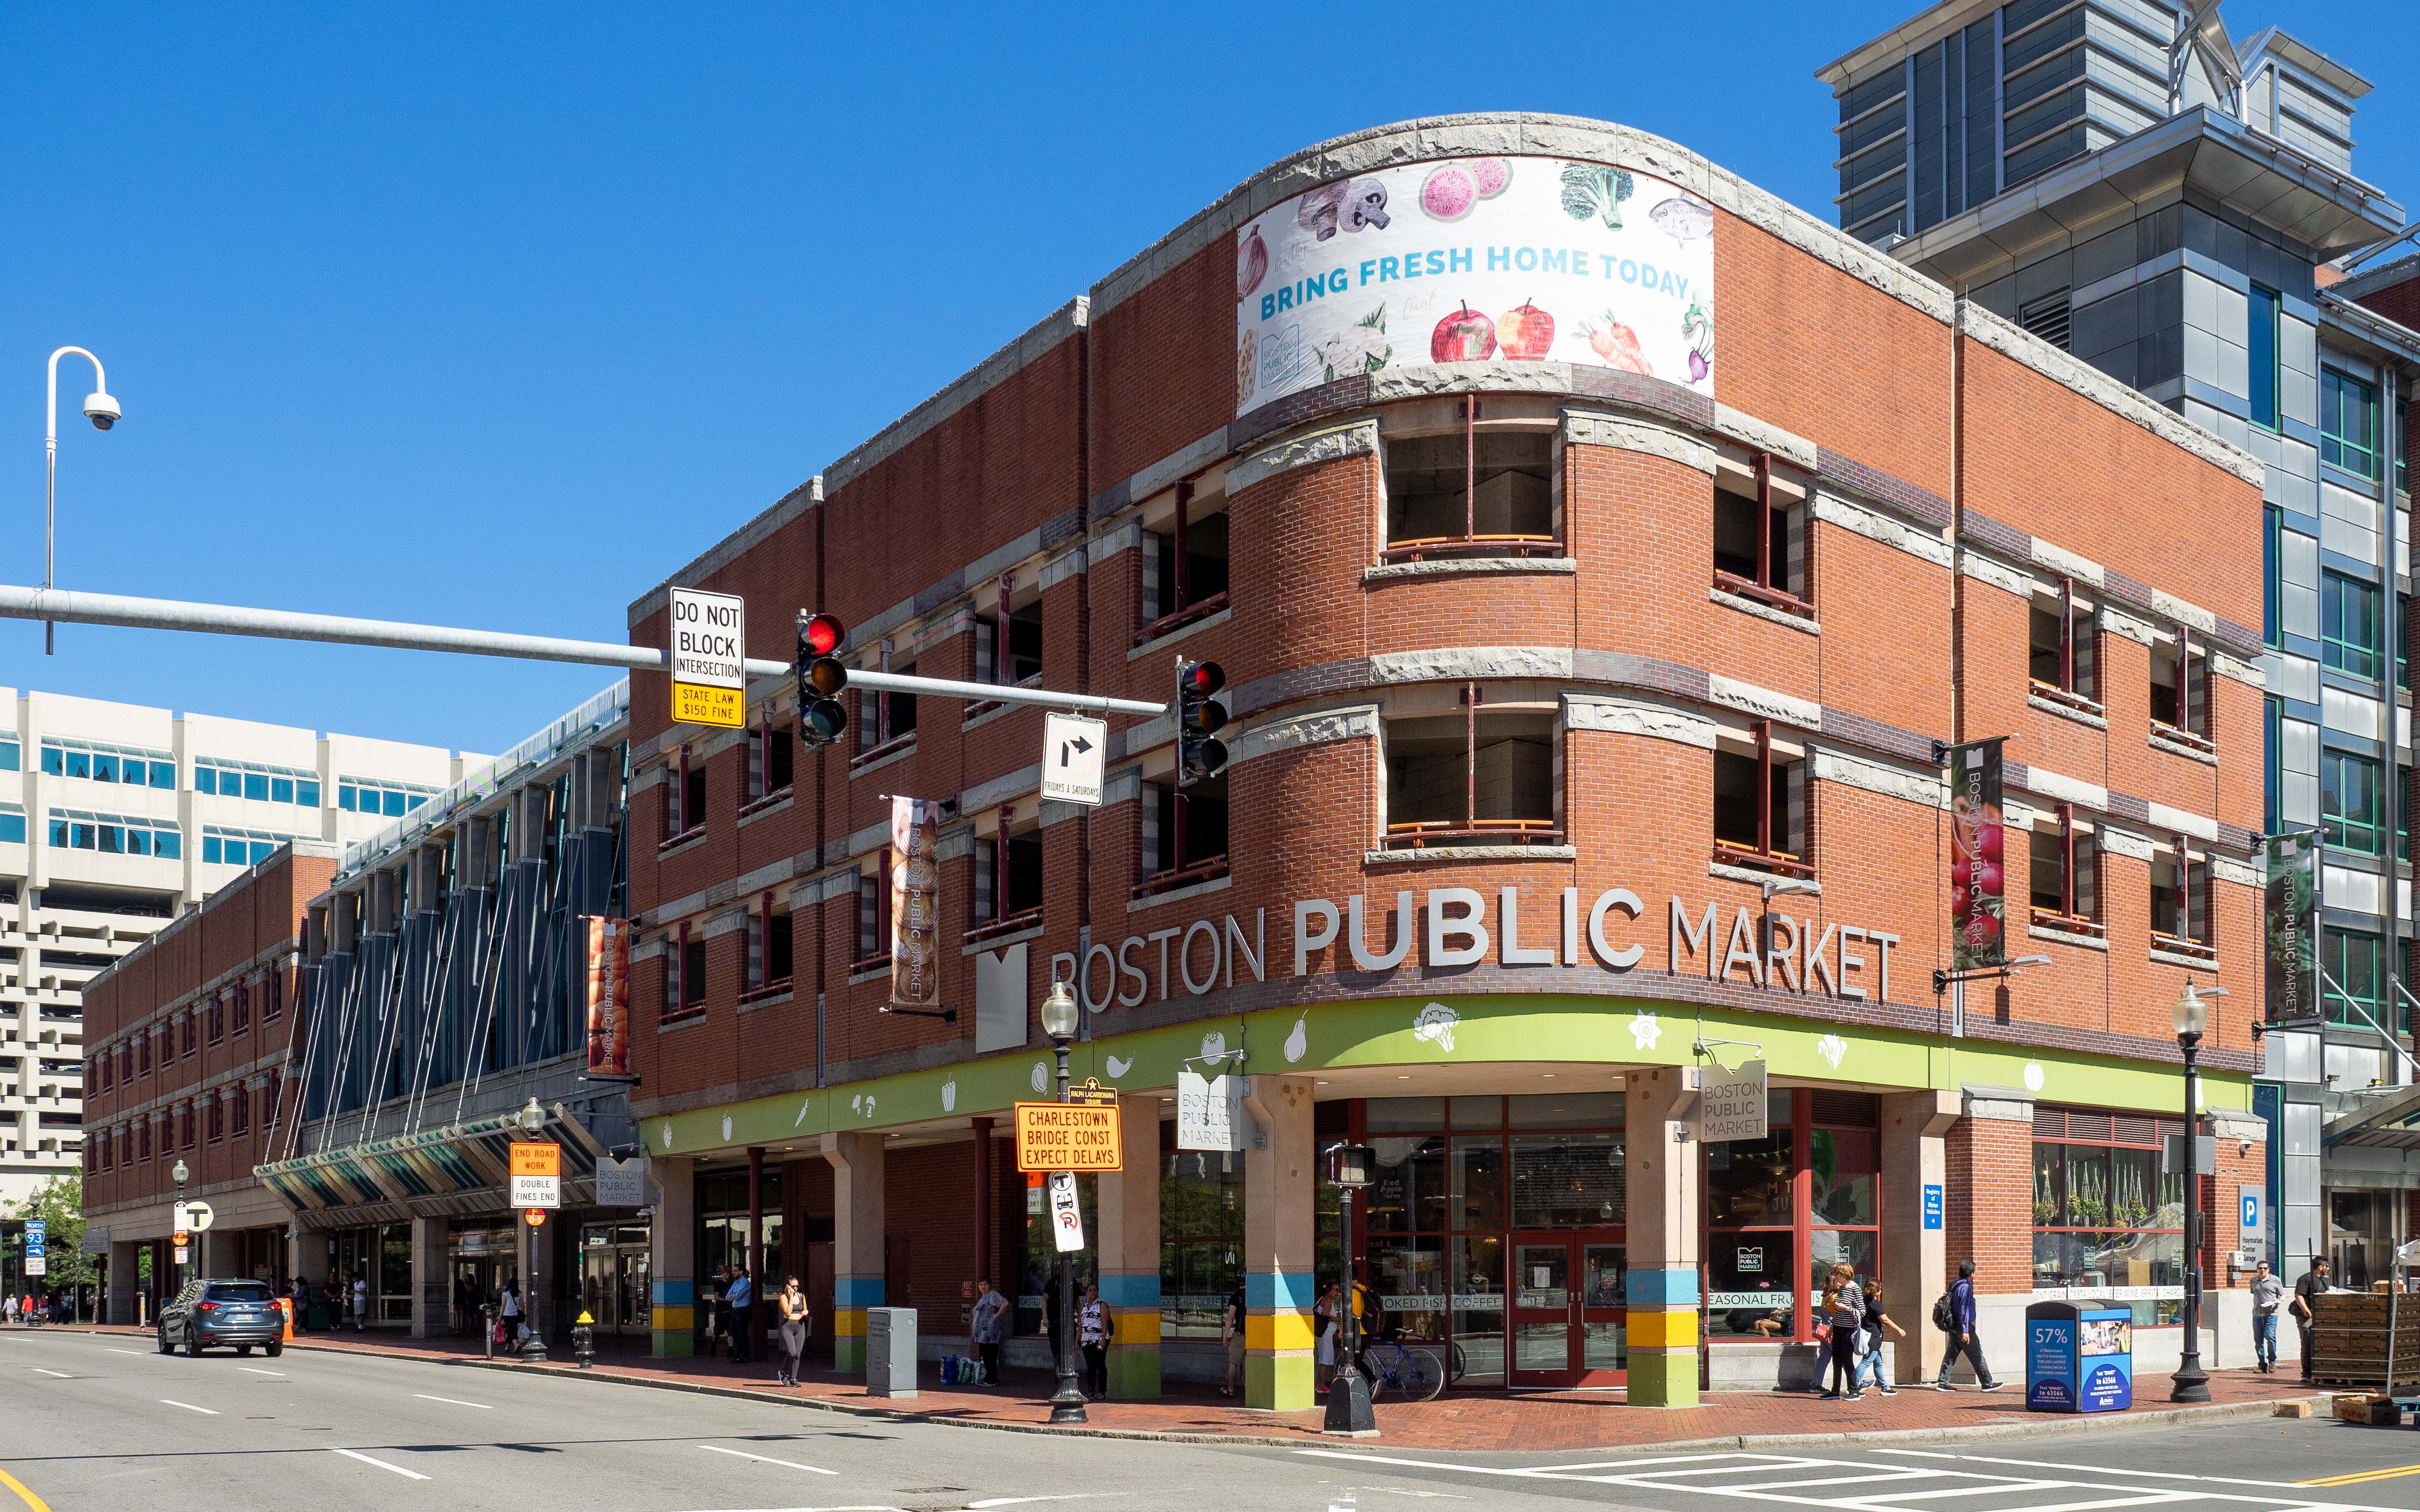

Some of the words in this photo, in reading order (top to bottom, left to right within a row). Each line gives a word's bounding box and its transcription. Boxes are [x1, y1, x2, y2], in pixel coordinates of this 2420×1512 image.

[1261, 268, 1348, 321] BRING
[1360, 247, 1472, 287] FRESH
[1488, 246, 1589, 276] HOME
[1599, 254, 1688, 300] TODAY
[1264, 340, 1296, 360] BOSTON
[1264, 353, 1292, 372] PUBLIC
[675, 601, 698, 622] DO
[707, 605, 739, 628] NOT
[680, 632, 735, 657] BLOCK
[676, 657, 740, 678] INTERSECTION
[683, 689, 710, 702] STATE
[716, 692, 734, 704] LAW
[684, 704, 706, 716] $150
[713, 707, 734, 719] FINE
[1045, 781, 1065, 793] FRIDAYS
[1072, 785, 1099, 797] SATURDAYS
[1969, 772, 1981, 836] BOSTON
[910, 827, 921, 886] BOSTON
[1970, 840, 1982, 895] PUBLIC
[2283, 859, 2295, 911] BOSTON
[911, 889, 921, 939] PUBLIC
[1971, 899, 1983, 960] MARKET
[2285, 914, 2295, 960] PUBLIC
[1052, 907, 1264, 1013] BOSTON
[1295, 887, 1645, 976] PUBLIC
[1672, 895, 1900, 1000] MARKET
[604, 939, 614, 985] BOSTON
[911, 942, 921, 1000] MARKET
[2285, 962, 2297, 1014] MARKET
[604, 986, 613, 1024] PUBLIC
[604, 1027, 613, 1069] MARKET
[1705, 1082, 1762, 1100] BOSTON
[1183, 1094, 1238, 1109] BOSTON
[1705, 1101, 1755, 1118] PUBLIC
[1029, 1111, 1108, 1127] CHARLESTOWN
[1183, 1111, 1230, 1127] PUBLIC
[1705, 1119, 1762, 1137] MARKET
[1028, 1130, 1069, 1145] BRIDGE
[1075, 1131, 1110, 1145] CONST
[1183, 1130, 1238, 1145] MARKET
[515, 1149, 530, 1158] END
[535, 1150, 555, 1158] ROAD
[1026, 1149, 1067, 1164] EXPECT
[1073, 1149, 1113, 1164] DELAYS
[600, 1170, 642, 1180] BOSTON
[600, 1182, 635, 1190] PUBLIC
[600, 1193, 641, 1202] MARKET
[187, 1209, 208, 1227] T
[2246, 1200, 2255, 1222] P
[27, 1233, 42, 1243] 93
[2242, 1236, 2263, 1245] Haymarket
[1019, 1298, 1040, 1306] ROASTED
[1423, 1298, 1446, 1308] FISH
[1454, 1297, 1501, 1308] COFFEE
[1697, 1295, 1766, 1305] SEASONAL
[1771, 1293, 1820, 1305] FRUTS
[2049, 1290, 2067, 1299] GRAIN
[2070, 1290, 2087, 1299] PASTA
[2089, 1289, 2106, 1298] LOCAL
[2109, 1289, 2122, 1298] BEER
[2124, 1289, 2138, 1297] WINE
[2141, 1289, 2157, 1297] SPIRIT
[2035, 1328, 2068, 1343] 57%
